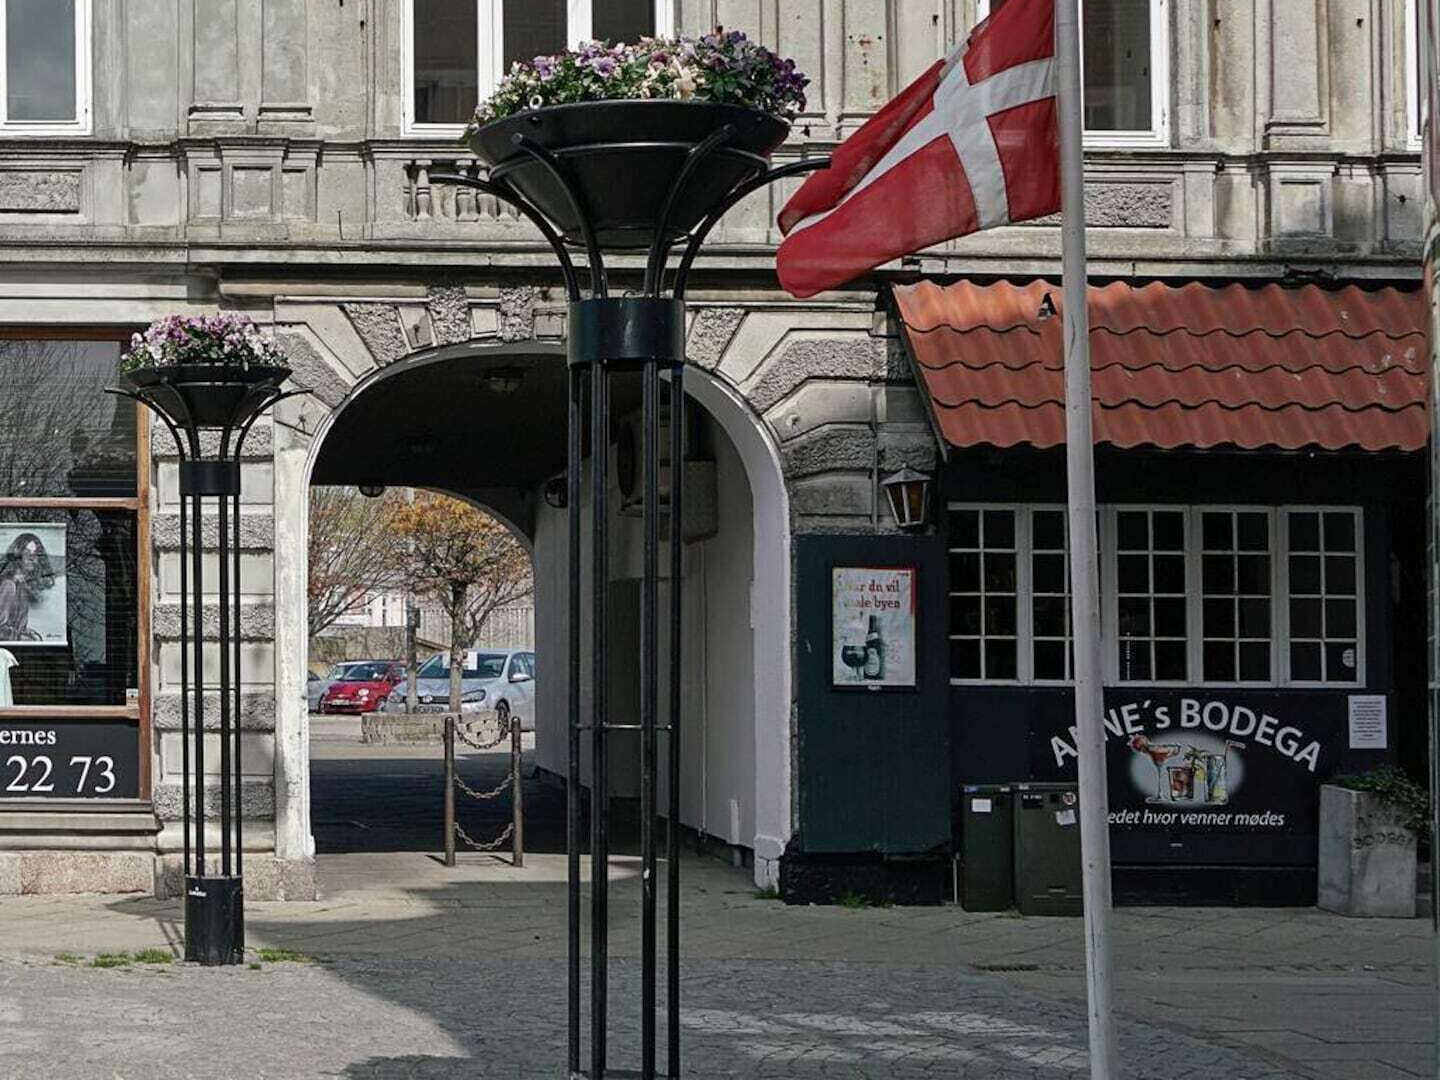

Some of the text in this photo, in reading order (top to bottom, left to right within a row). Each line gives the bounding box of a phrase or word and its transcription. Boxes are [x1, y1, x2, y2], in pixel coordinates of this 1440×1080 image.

[1180, 698, 1321, 773] BODEGA
[6, 755, 55, 792] 22
[69, 755, 116, 793] 73
[1109, 809, 1285, 826] edet hvor venner mødes
